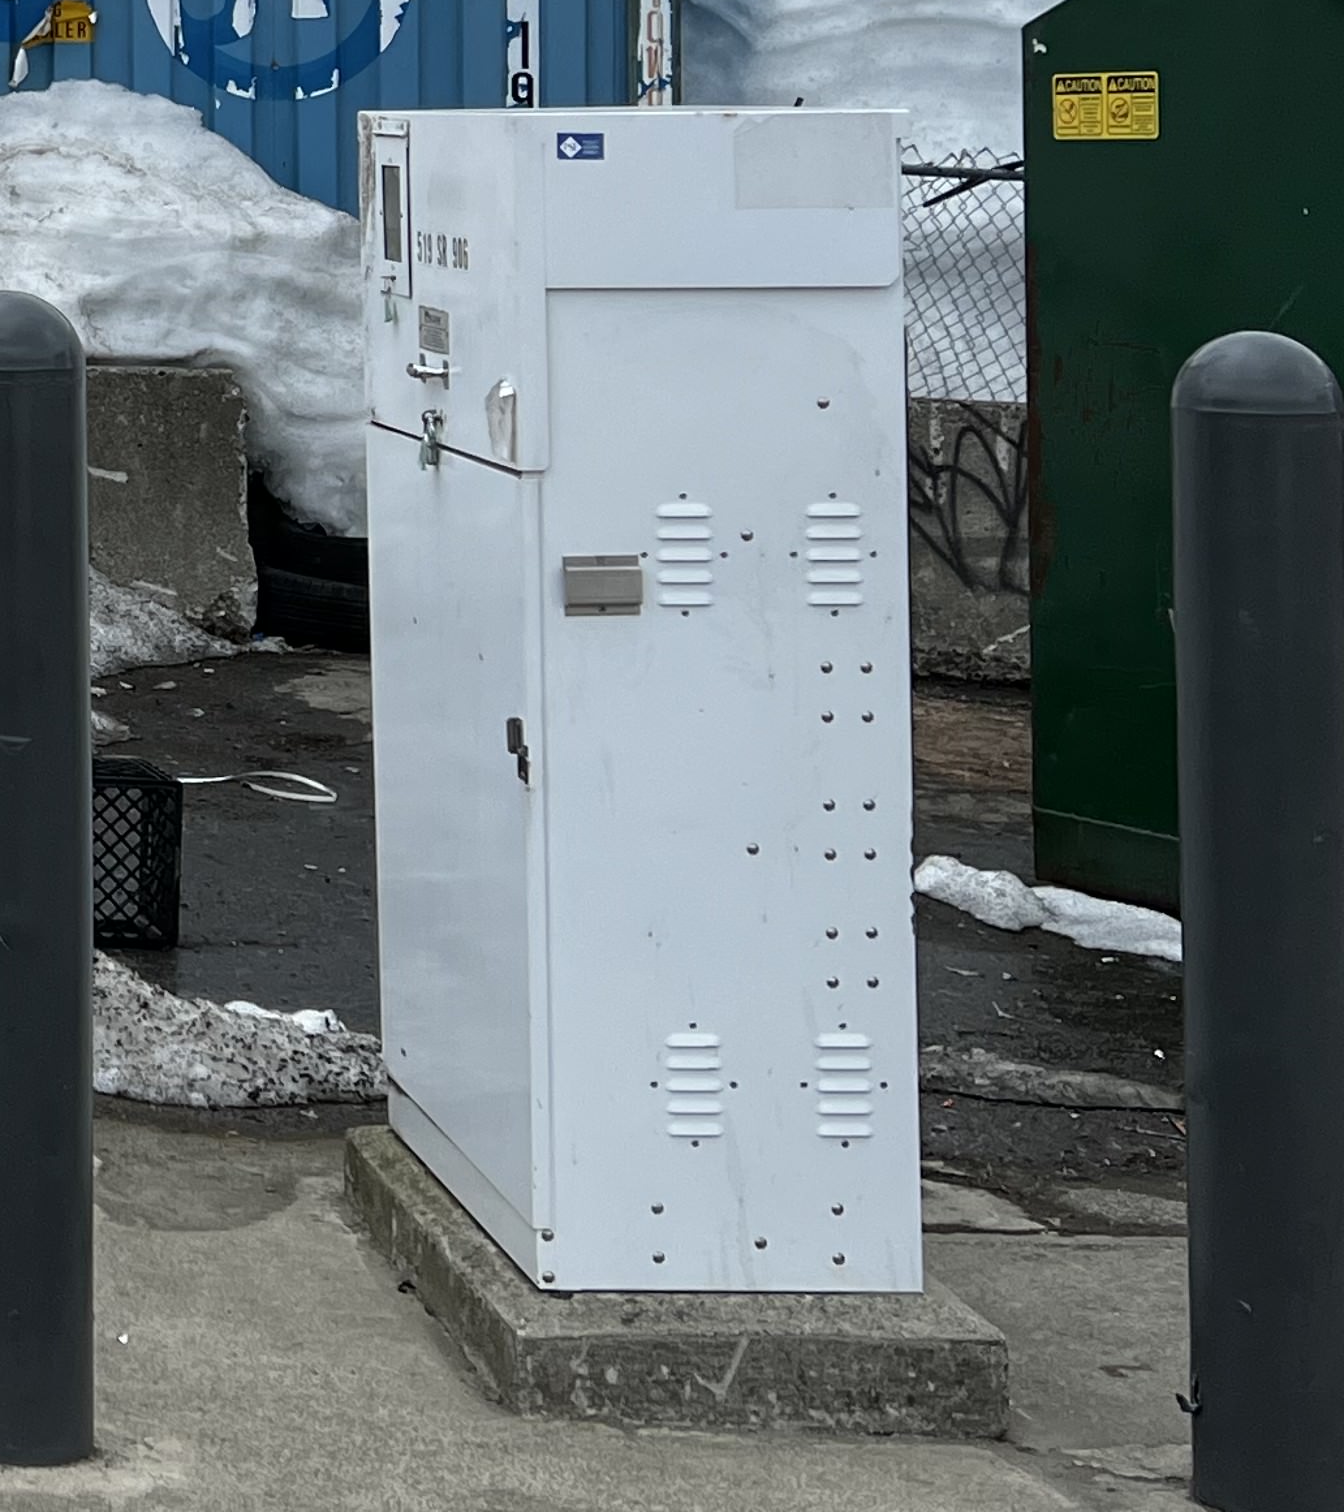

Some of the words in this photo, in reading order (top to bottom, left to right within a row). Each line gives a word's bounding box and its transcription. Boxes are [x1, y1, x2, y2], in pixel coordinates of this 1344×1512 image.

[1065, 78, 1102, 92] CAUTION
[1117, 77, 1155, 91] CAUTION
[417, 231, 433, 265] 519
